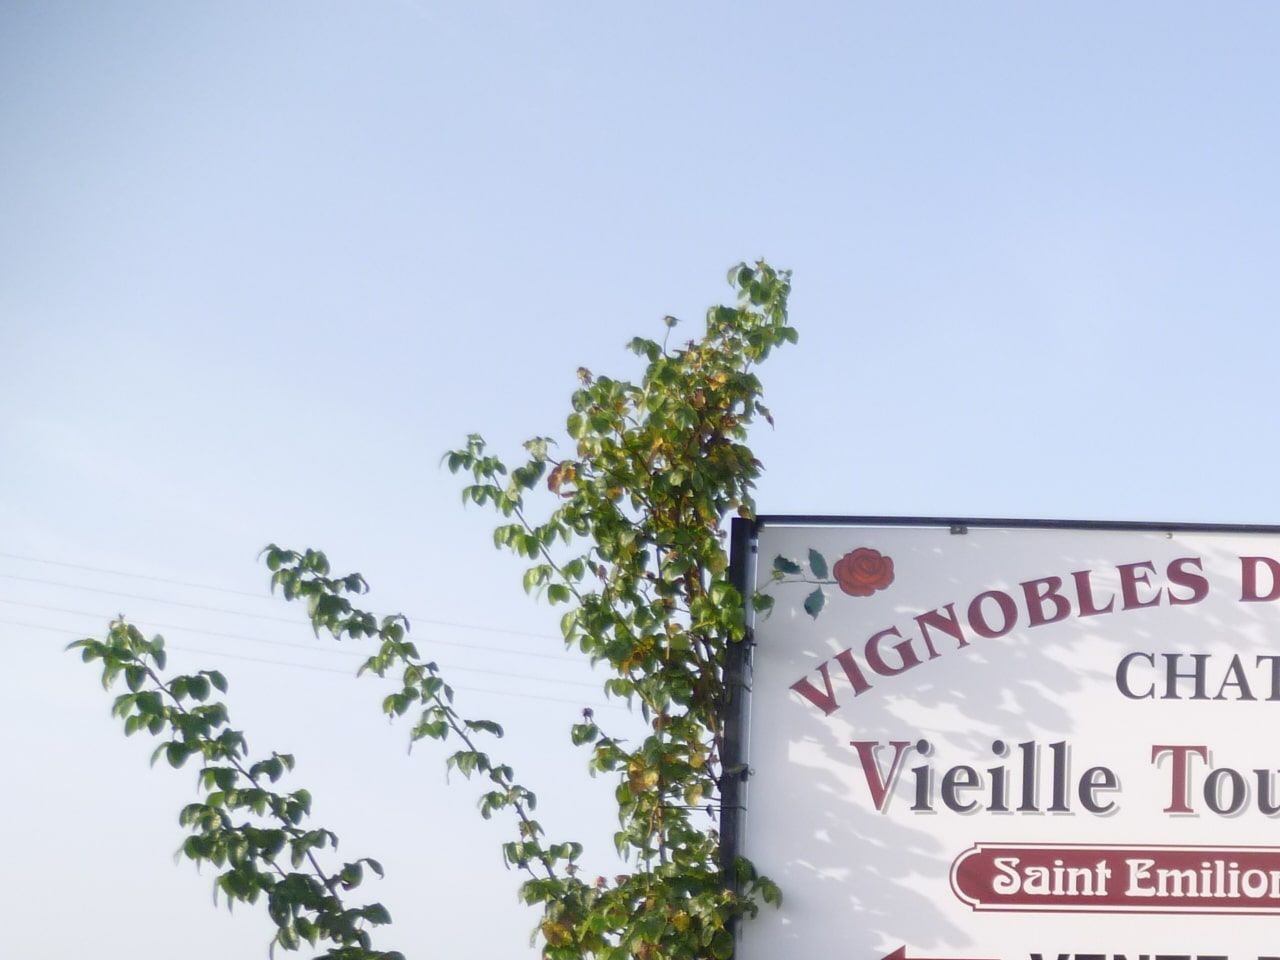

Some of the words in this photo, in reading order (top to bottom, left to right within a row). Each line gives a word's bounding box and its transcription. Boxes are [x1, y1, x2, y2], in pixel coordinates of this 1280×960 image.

[790, 556, 1210, 717] VIGNOBLES
[850, 739, 1121, 817] Vieille
[991, 856, 1111, 897] Saint
